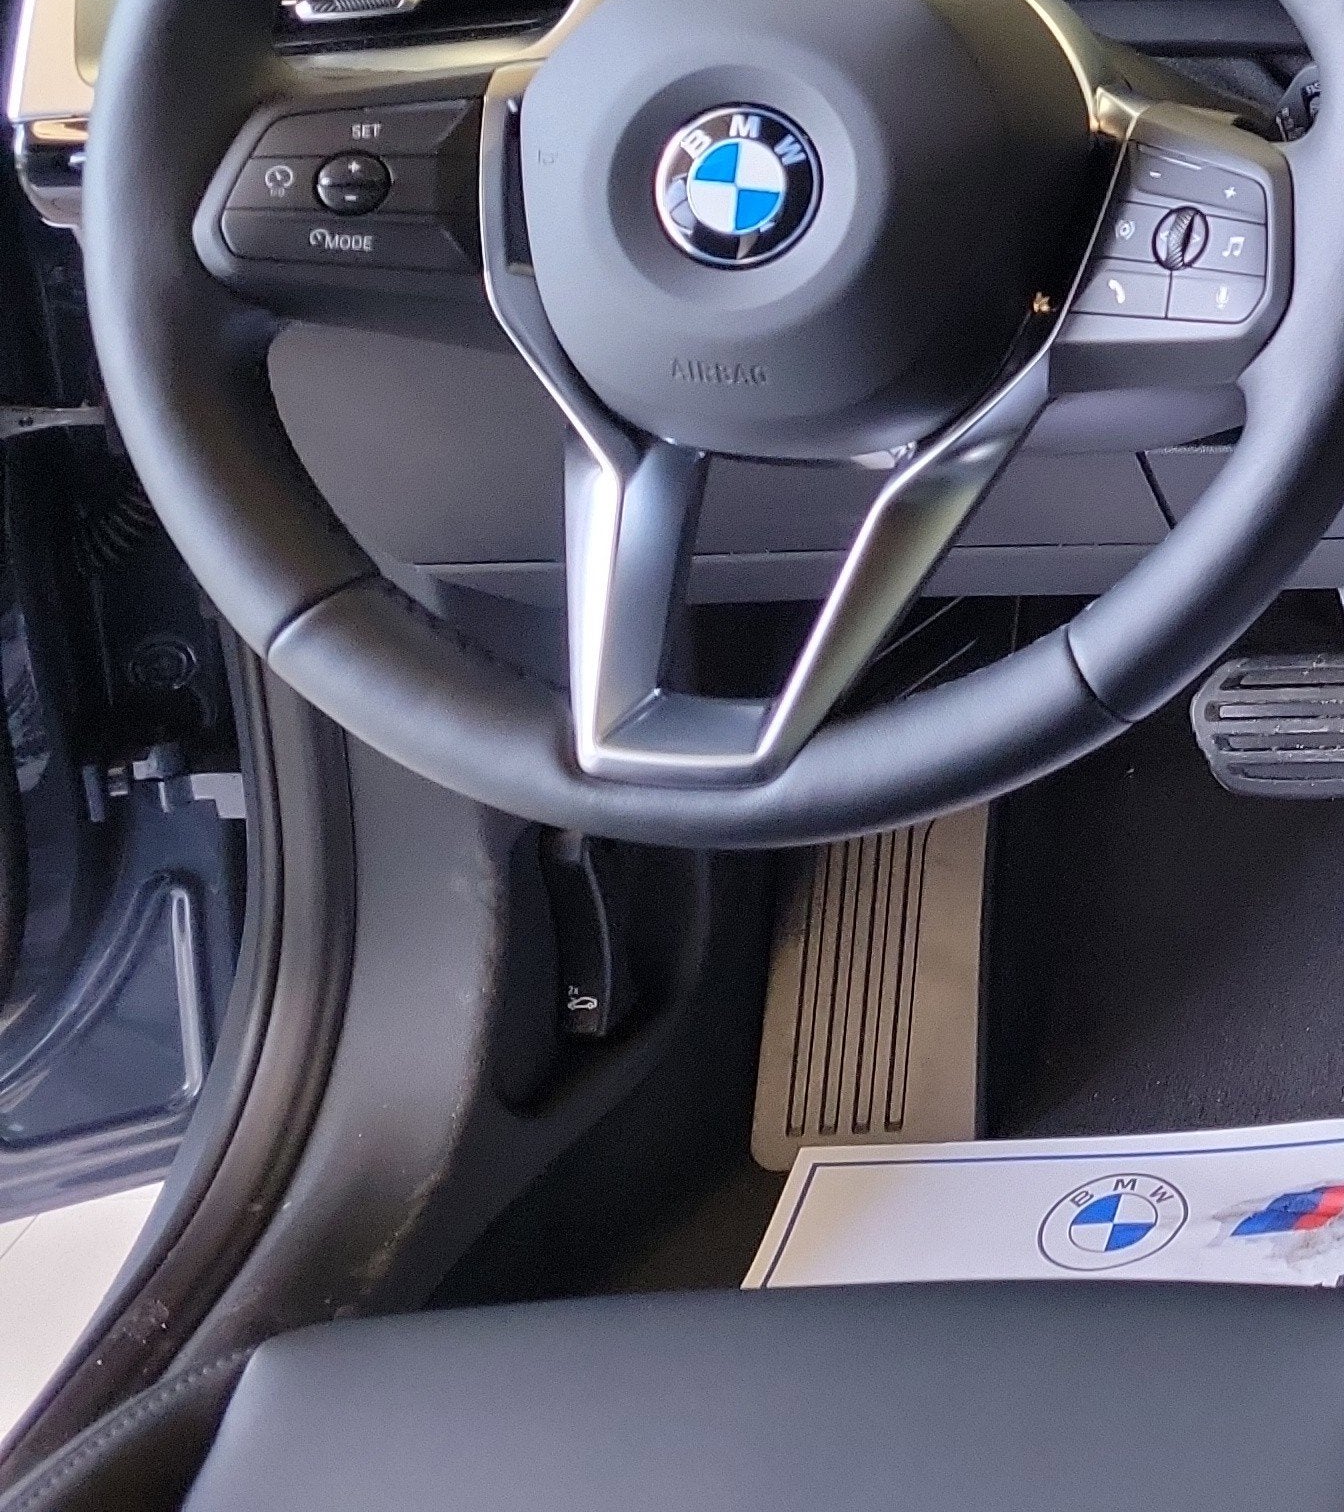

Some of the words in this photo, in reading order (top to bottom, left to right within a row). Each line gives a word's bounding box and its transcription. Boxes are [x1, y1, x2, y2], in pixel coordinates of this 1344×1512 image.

[351, 123, 382, 139] SET
[324, 234, 373, 252] MODE
[1070, 1178, 1176, 1207] BMW
